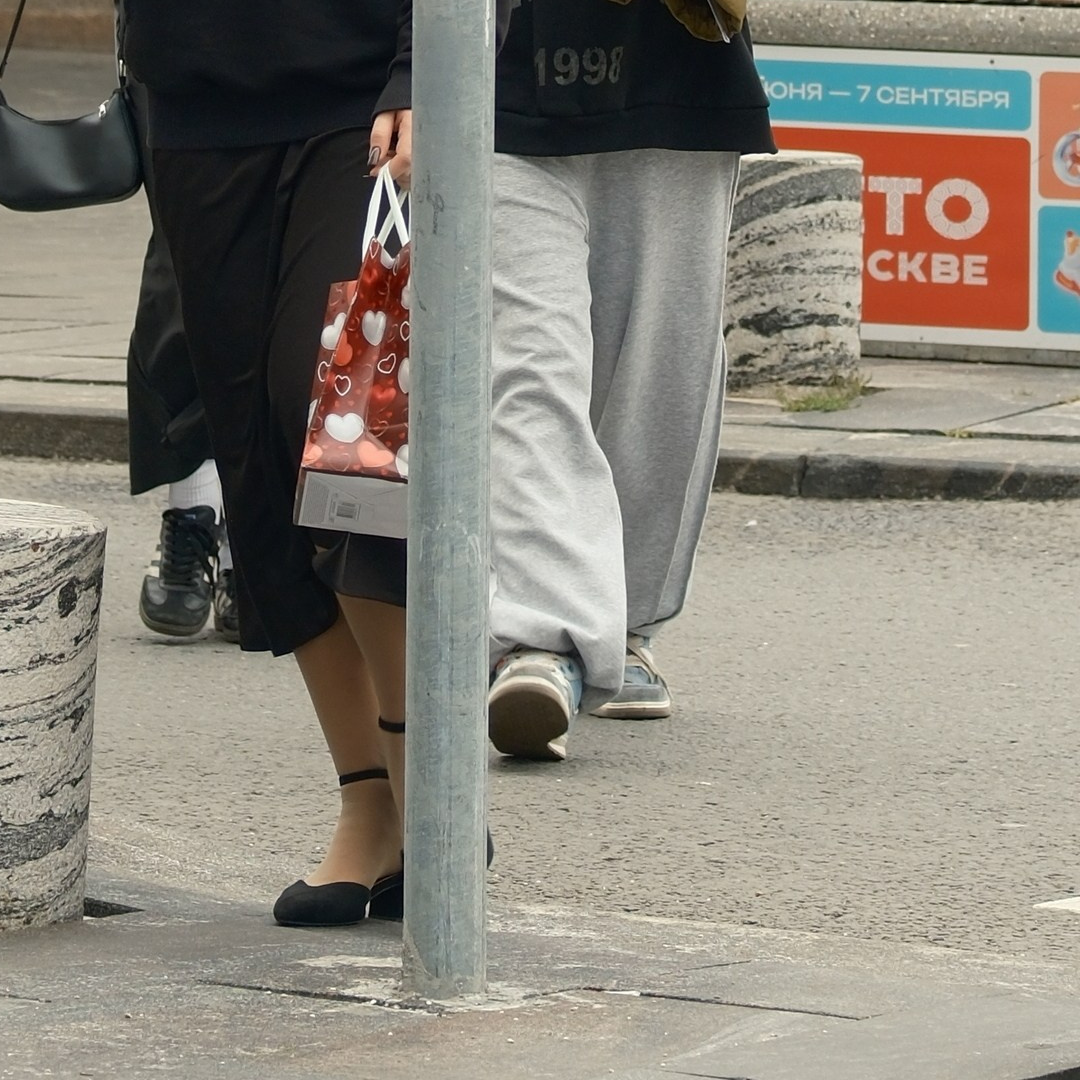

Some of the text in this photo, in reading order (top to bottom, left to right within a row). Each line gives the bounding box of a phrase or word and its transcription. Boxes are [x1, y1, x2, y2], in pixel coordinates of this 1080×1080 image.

[534, 46, 625, 87] 1998
[857, 84, 872, 104] 7
[876, 85, 1010, 109] СЕНТЯБРЯ
[862, 175, 990, 241] ТО
[865, 248, 988, 286] СКВЕ
